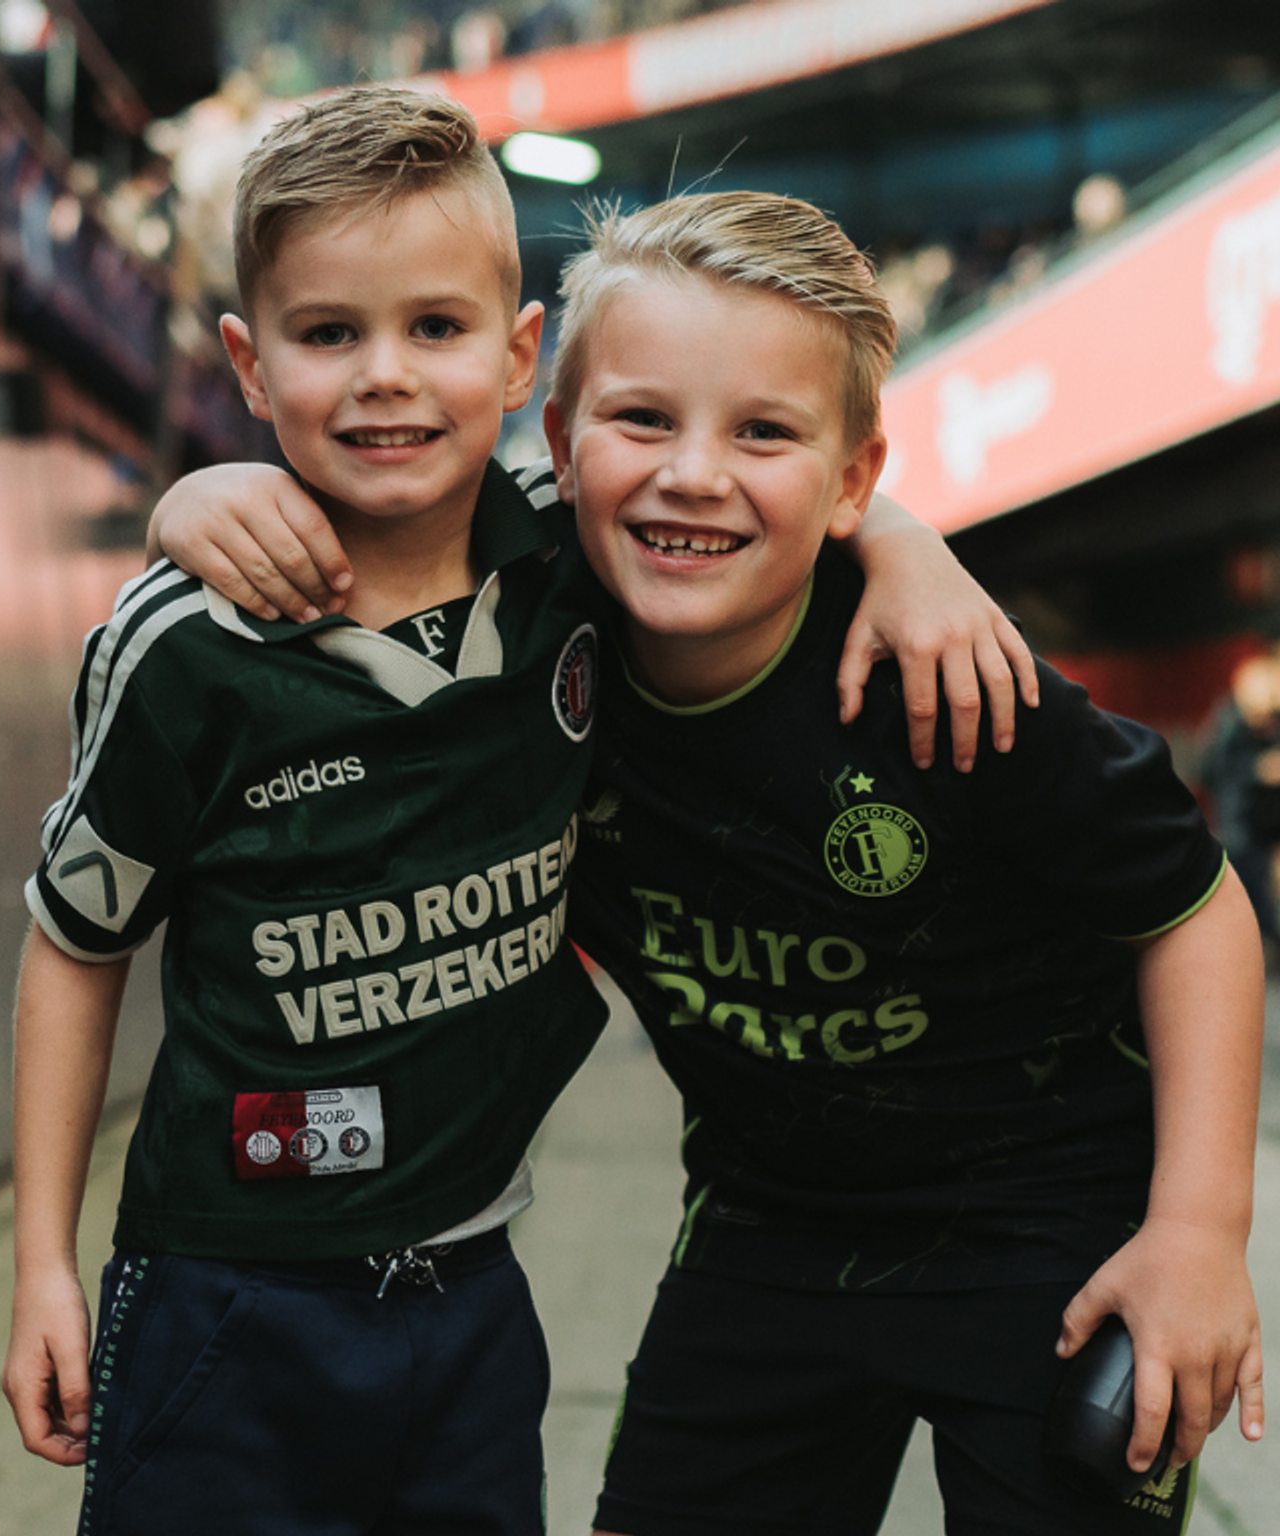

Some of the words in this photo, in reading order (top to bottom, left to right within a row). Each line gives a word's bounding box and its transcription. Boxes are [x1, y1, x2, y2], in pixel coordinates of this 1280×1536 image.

[410, 609, 446, 658] F
[244, 756, 365, 810] adidas
[829, 807, 915, 847] FEYENOORD
[837, 853, 924, 894] ROTTERDAM
[252, 900, 407, 978] STAD
[631, 886, 868, 987] Euro
[111, 1287, 136, 1334] CITY
[97, 1342, 118, 1393] YORK
[89, 1402, 106, 1447] NEW
